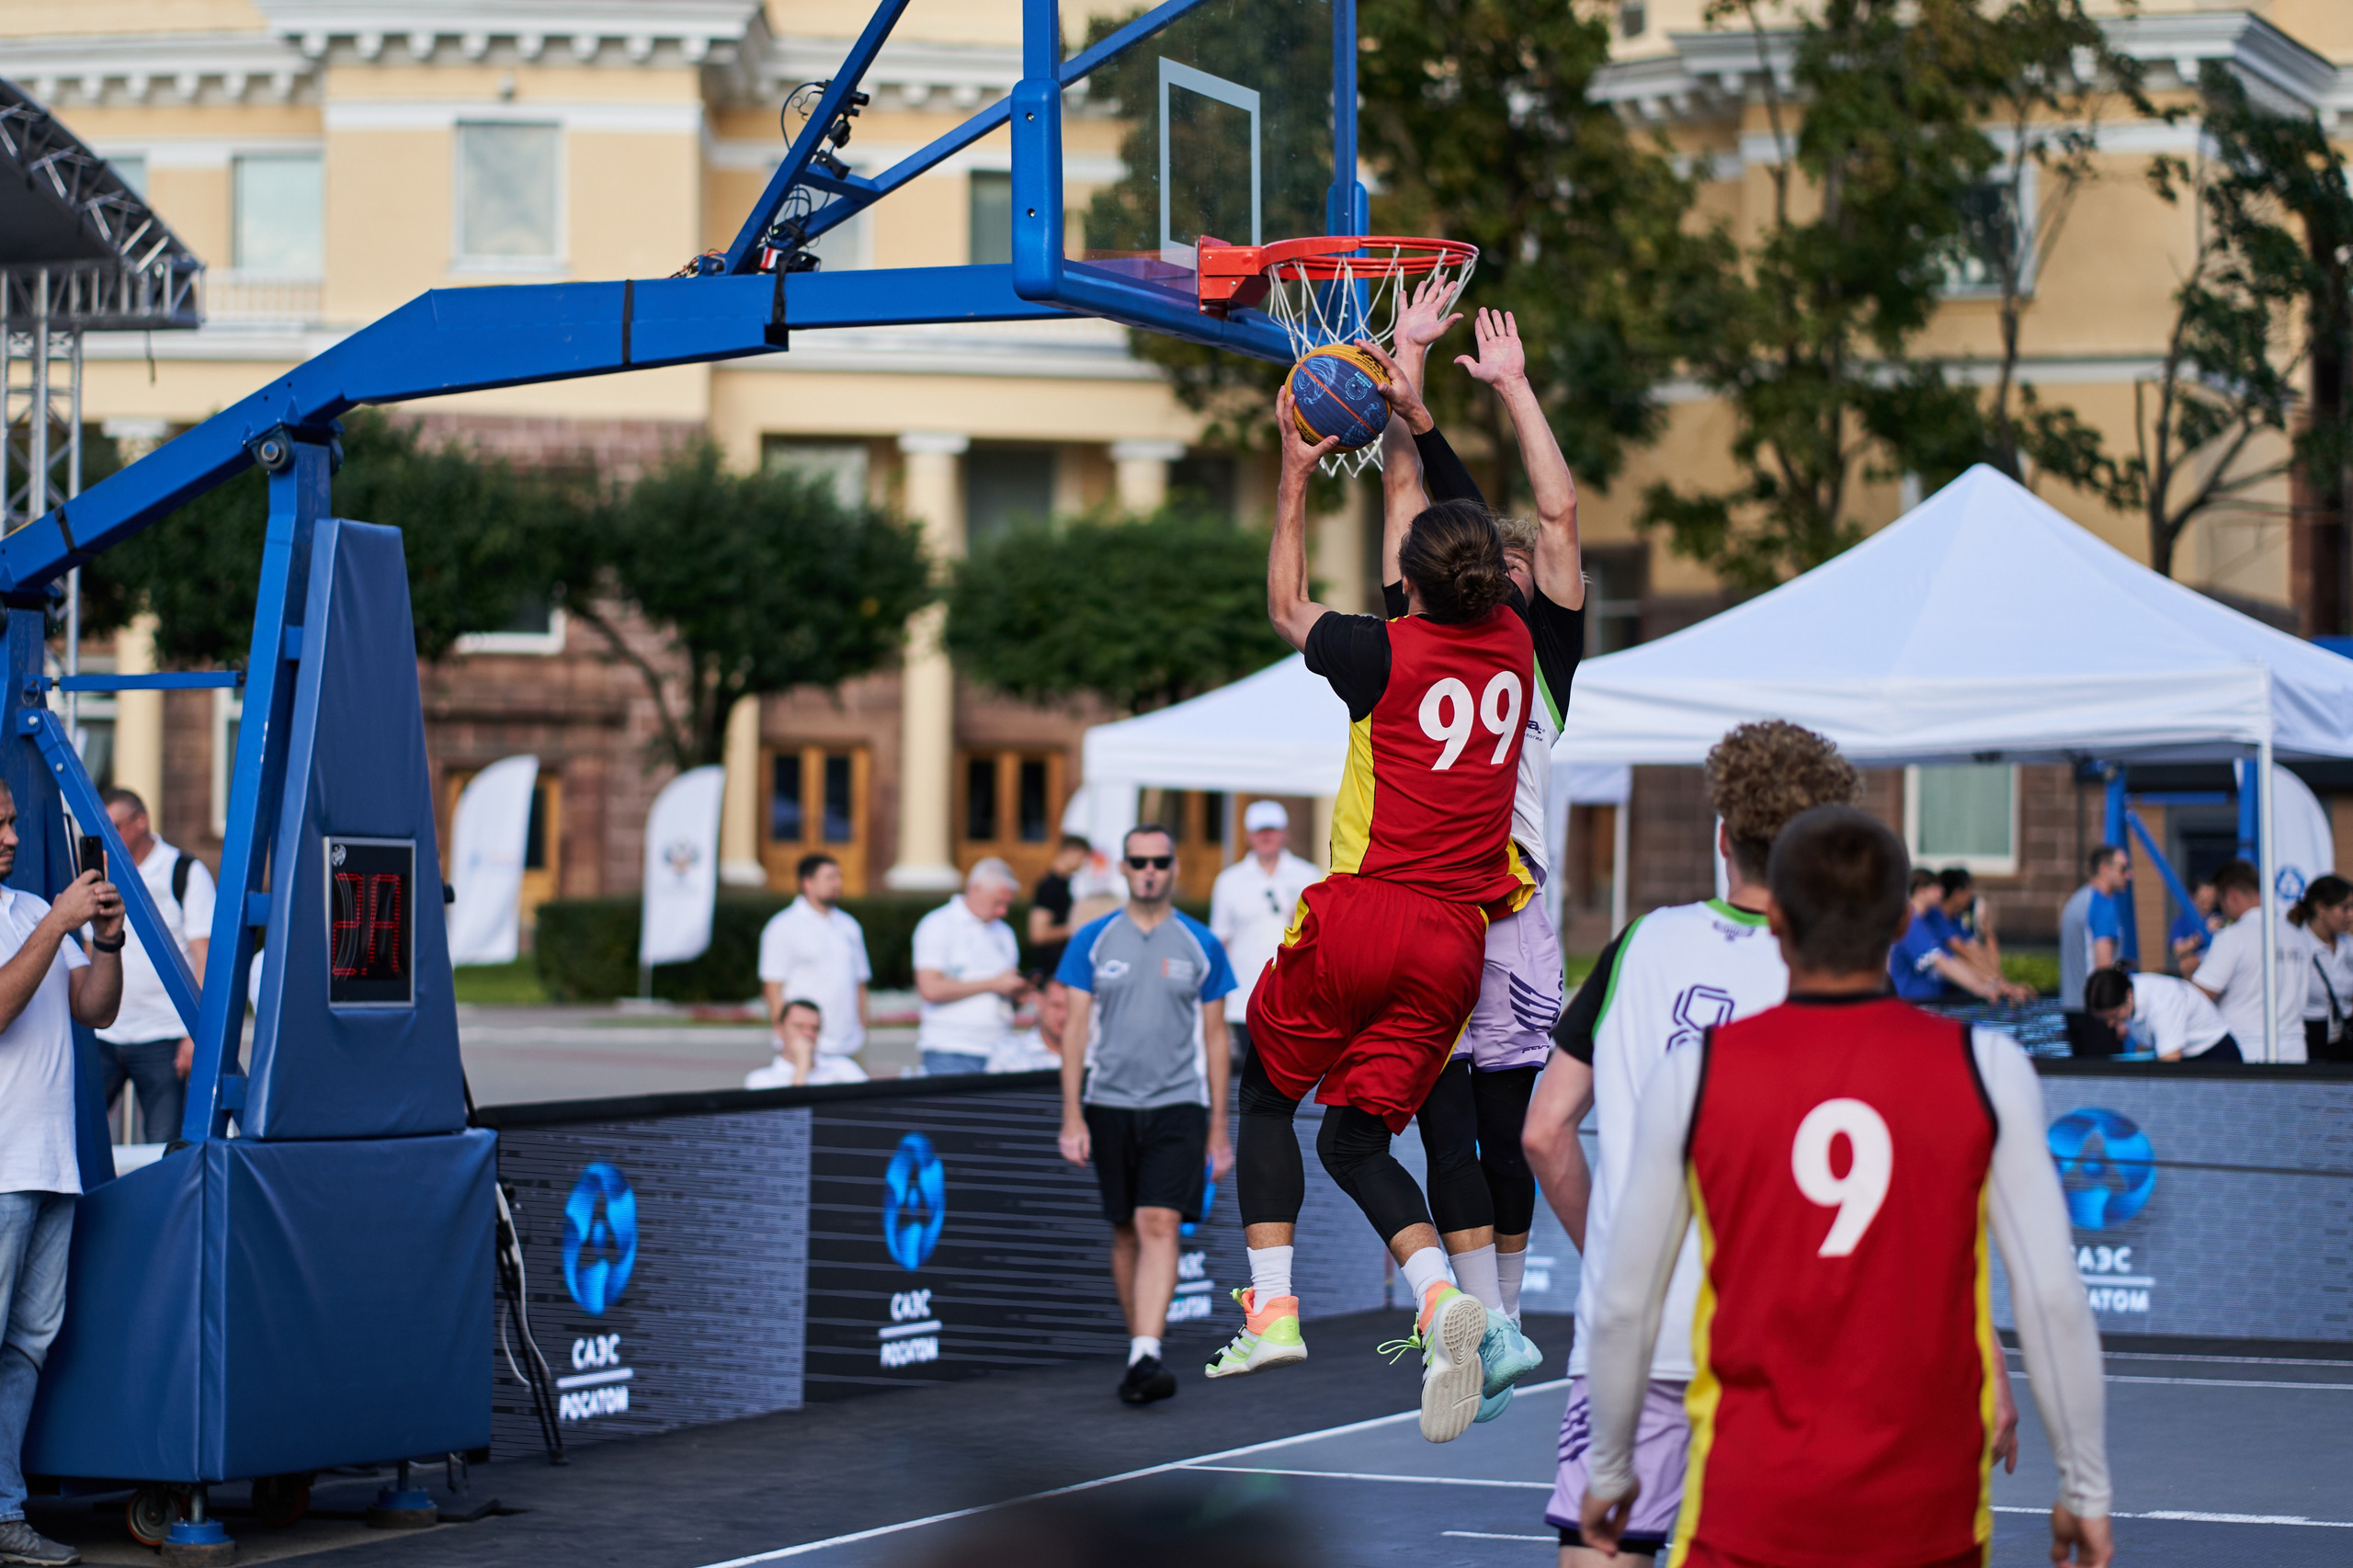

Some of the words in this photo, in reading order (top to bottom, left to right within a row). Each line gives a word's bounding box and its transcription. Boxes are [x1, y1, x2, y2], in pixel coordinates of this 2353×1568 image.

[1418, 670, 1523, 771] 99
[1791, 1097, 1894, 1258] 9
[2071, 1244, 2132, 1272] АЭС
